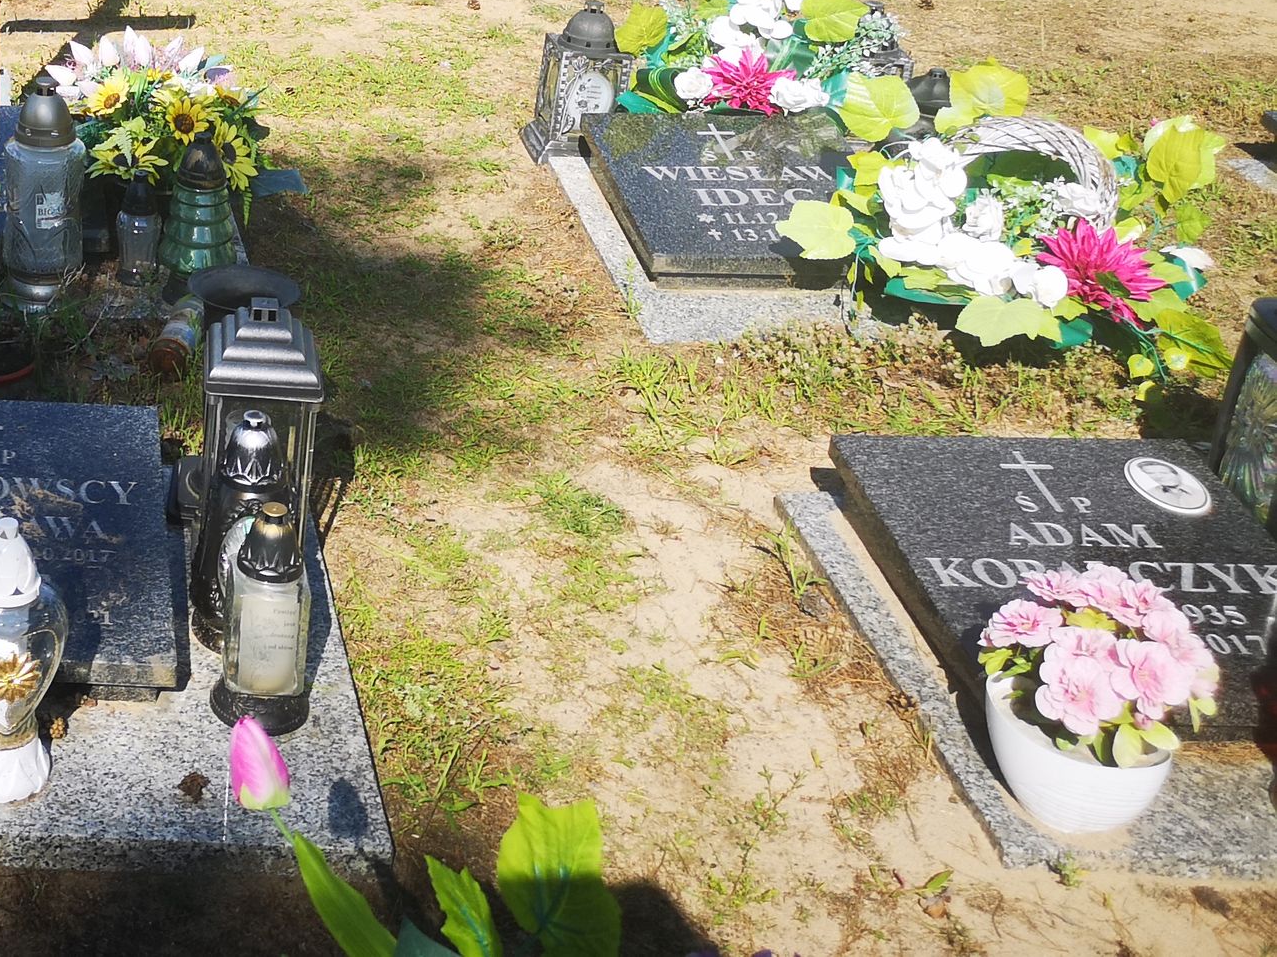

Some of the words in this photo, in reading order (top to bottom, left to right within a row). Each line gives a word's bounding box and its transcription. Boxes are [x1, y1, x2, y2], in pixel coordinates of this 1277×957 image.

[1, 448, 16, 465] P
[1014, 491, 1039, 513] Ś
[1070, 496, 1093, 514] P
[1009, 521, 1163, 549] ADAM
